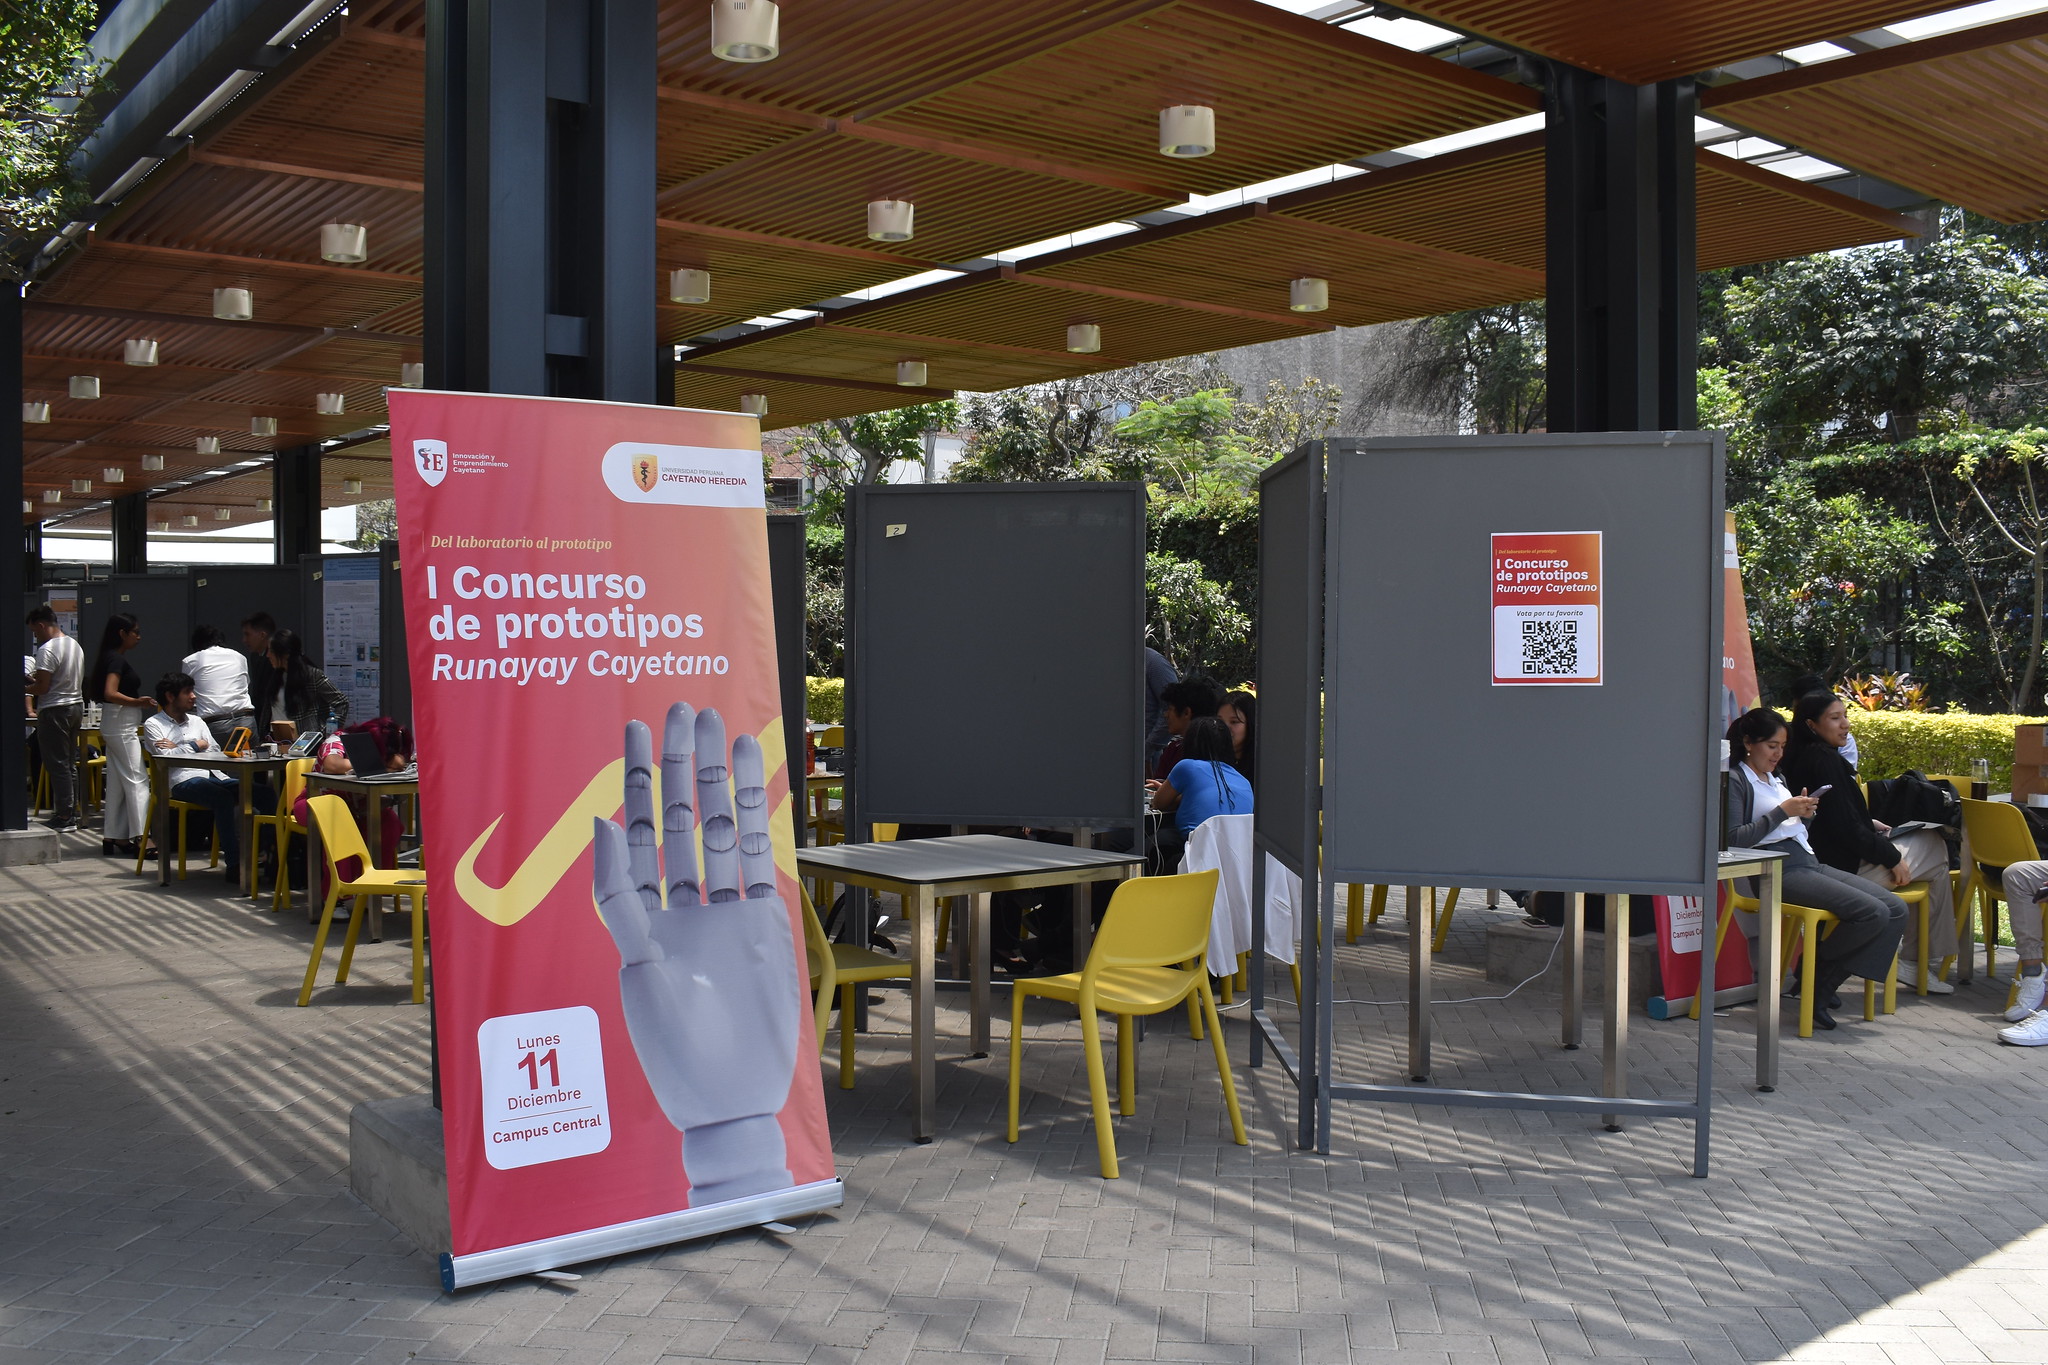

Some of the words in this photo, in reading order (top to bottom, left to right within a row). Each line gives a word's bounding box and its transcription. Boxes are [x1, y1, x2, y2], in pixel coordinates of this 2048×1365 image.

[452, 460, 509, 468] Emprendimiento
[661, 467, 698, 475] UNIVERSIDAD
[661, 473, 707, 484] CAYETANO
[708, 477, 747, 486] HEREDIA
[893, 527, 900, 535] 2
[430, 535, 453, 548] Del
[456, 535, 533, 549] laboratorio
[536, 537, 549, 549] al
[551, 538, 612, 552] prototipo
[1496, 559, 1501, 569] I
[1504, 558, 1569, 569] Concurso
[426, 565, 437, 599] I
[452, 565, 646, 600] Concurso
[1496, 570, 1513, 581] de
[1516, 569, 1589, 584] prototipos
[1496, 584, 1543, 595] Runayay
[1545, 583, 1598, 595] Cayetano
[1555, 609, 1584, 618] favorito
[429, 604, 481, 641] de
[495, 603, 704, 649] prototipos
[432, 653, 579, 686] Runayay
[587, 649, 730, 684] Cayetano
[1676, 909, 1703, 920] Diciembr
[1672, 930, 1695, 939] Campus
[517, 1034, 561, 1050] Lunes
[517, 1048, 560, 1090] 11
[507, 1089, 581, 1110] Diciembre
[492, 1126, 549, 1143] Campus
[552, 1113, 602, 1133] Central
